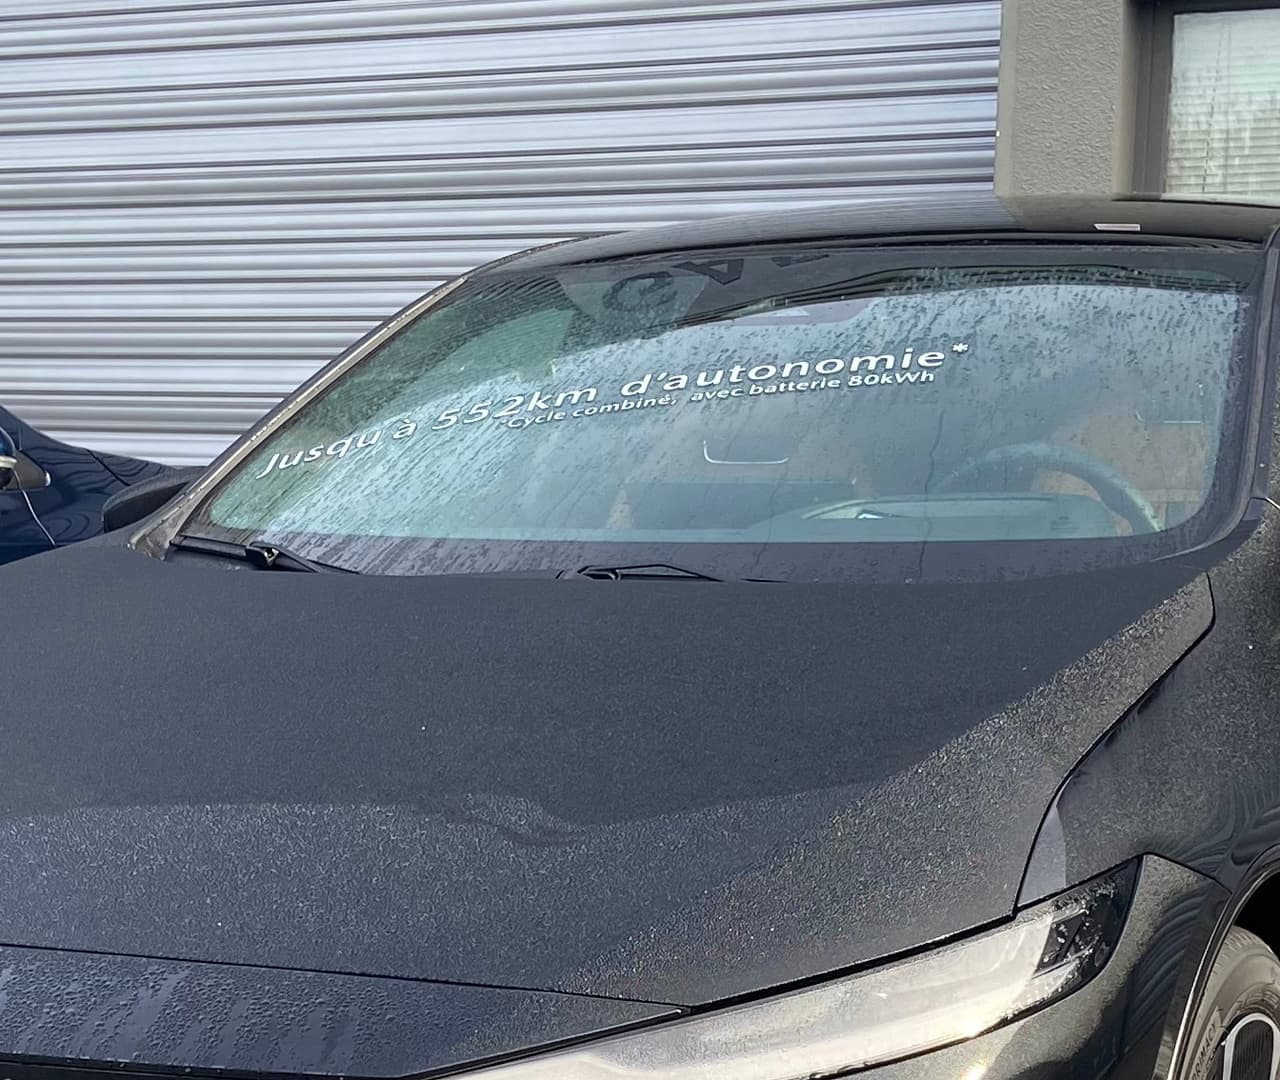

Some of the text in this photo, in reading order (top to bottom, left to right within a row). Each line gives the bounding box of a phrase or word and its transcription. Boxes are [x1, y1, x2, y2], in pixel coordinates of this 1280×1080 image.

[691, 387, 743, 402] avec
[749, 376, 840, 396] batterie
[847, 370, 935, 387] 80kWh
[431, 387, 597, 432] 552km
